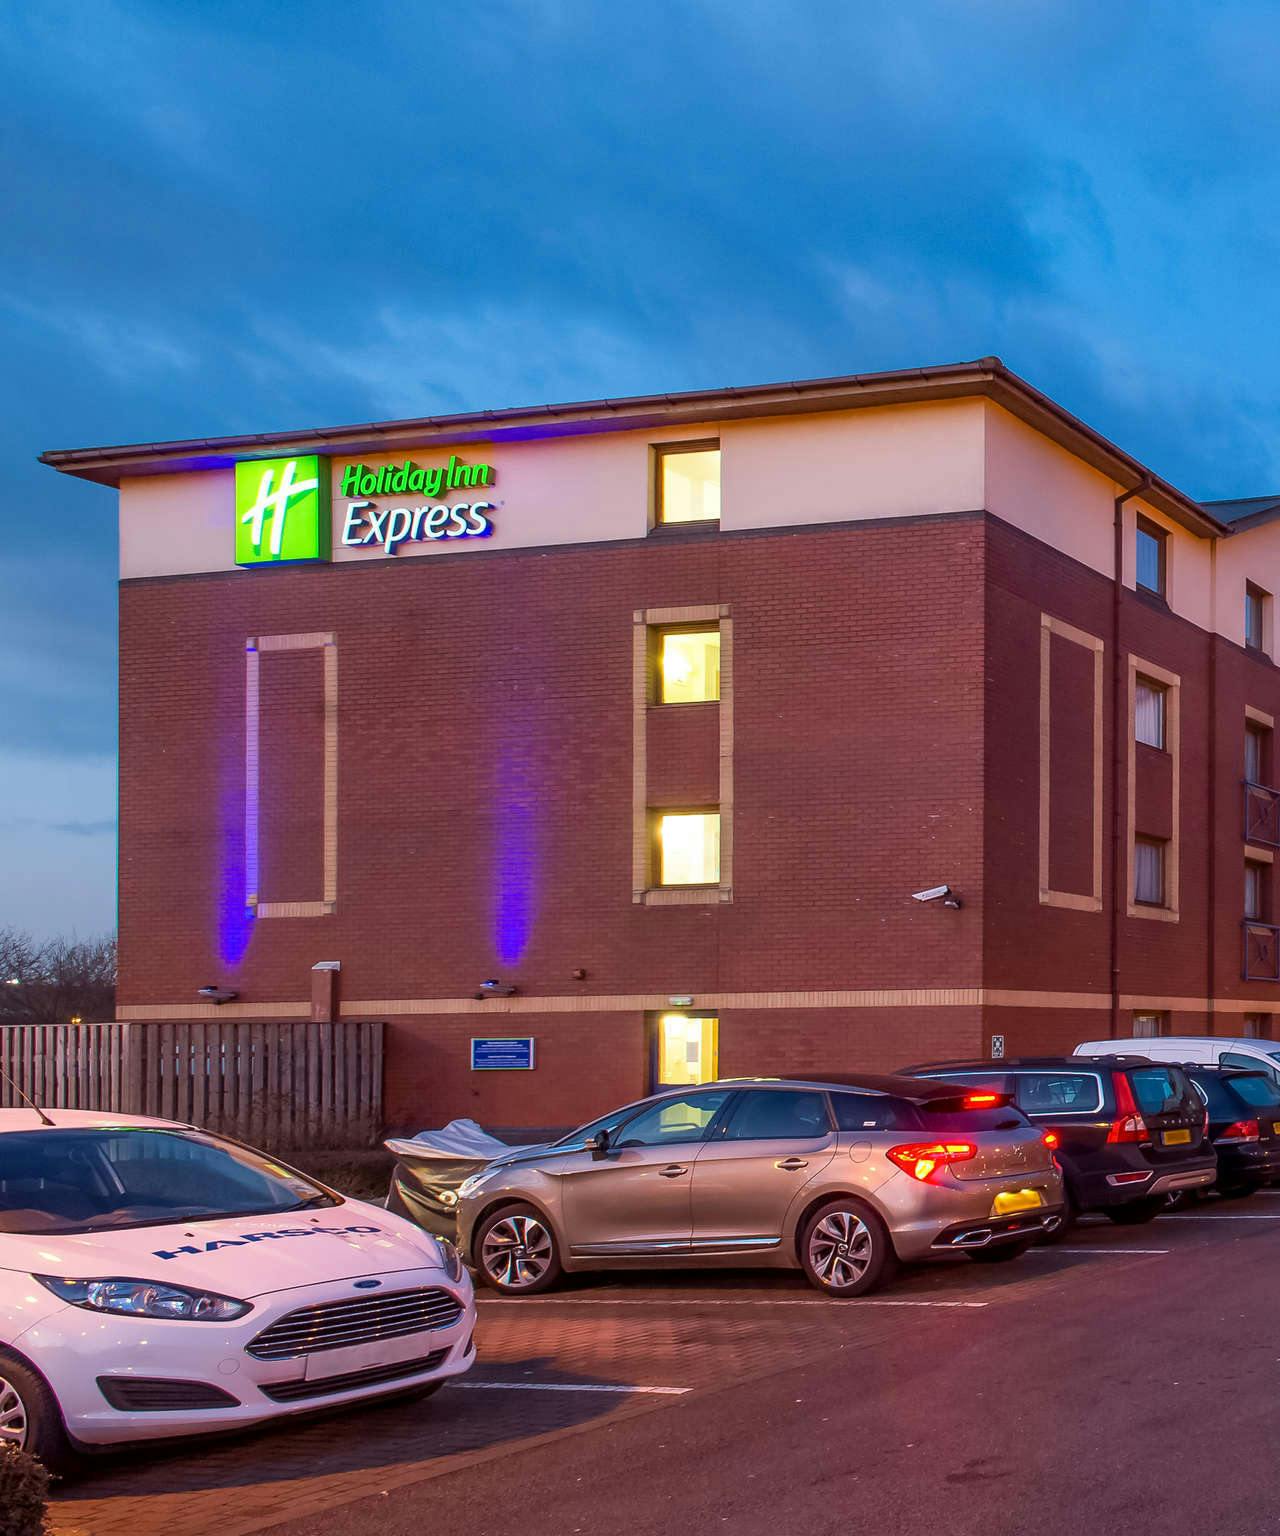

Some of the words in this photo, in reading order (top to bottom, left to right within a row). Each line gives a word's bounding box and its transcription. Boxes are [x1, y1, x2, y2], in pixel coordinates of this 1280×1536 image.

[341, 461, 442, 497] Holiday
[446, 455, 488, 487] Inn
[341, 501, 490, 554] Express
[151, 1226, 381, 1260] HARSCO
